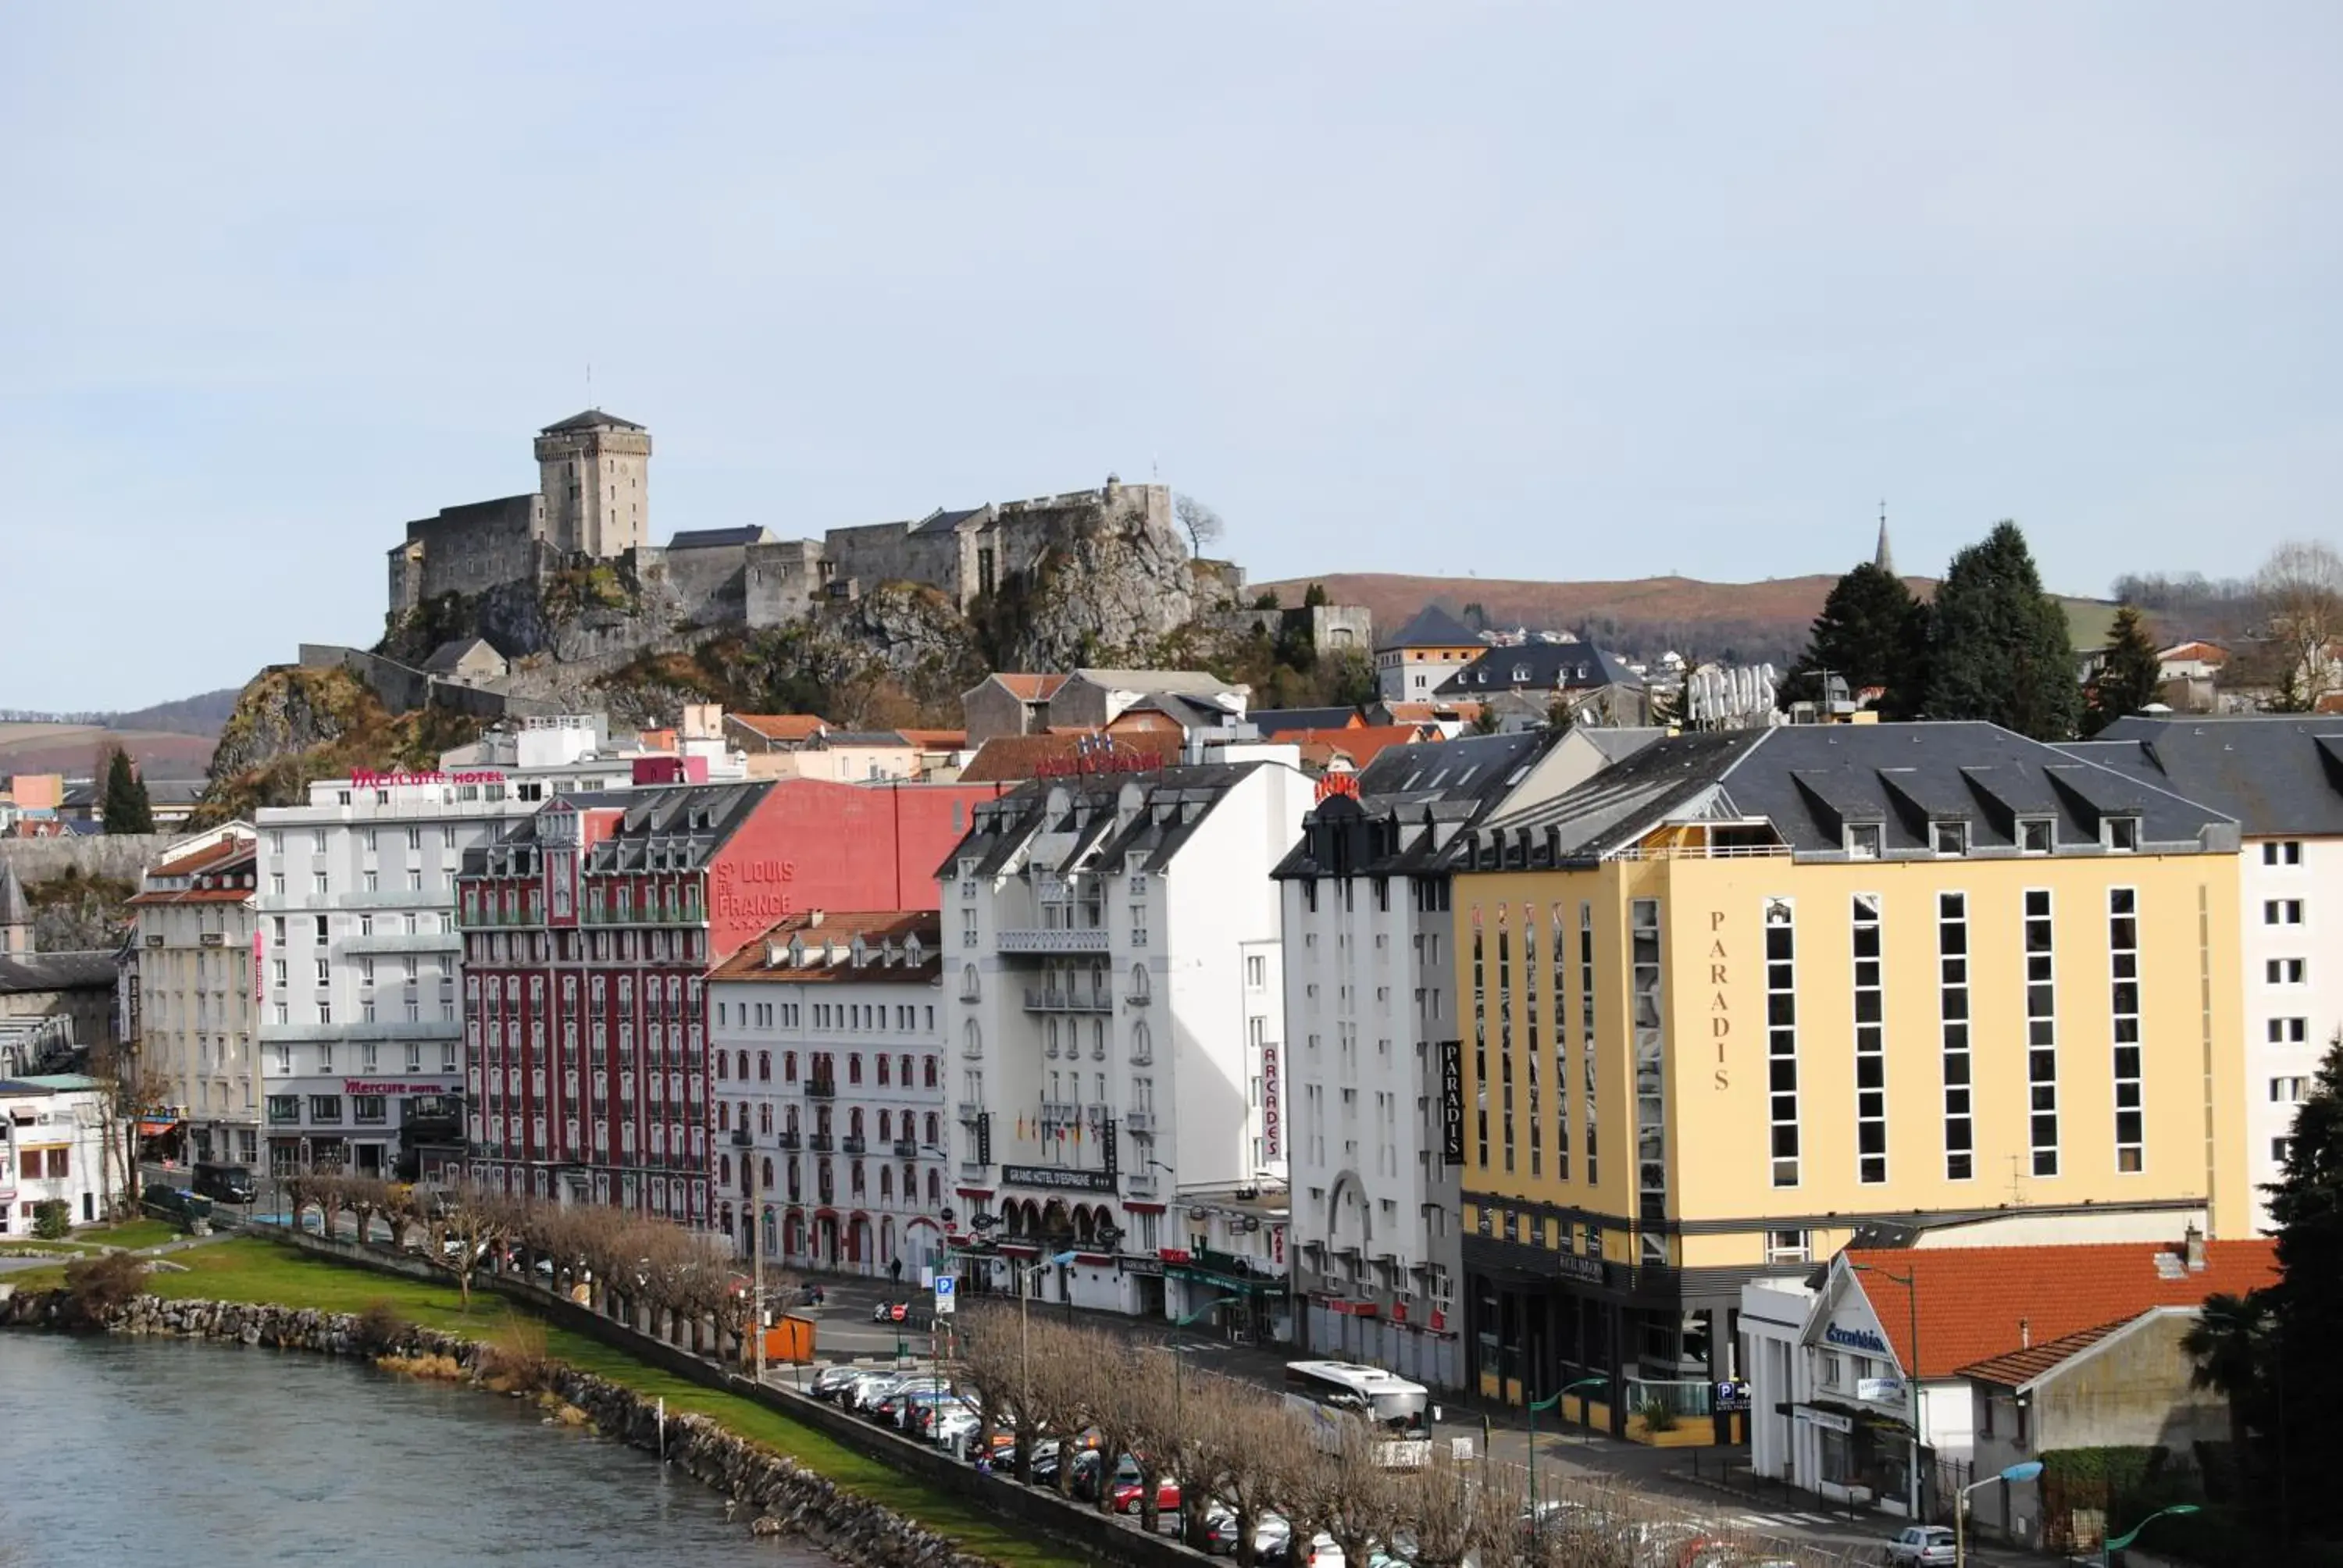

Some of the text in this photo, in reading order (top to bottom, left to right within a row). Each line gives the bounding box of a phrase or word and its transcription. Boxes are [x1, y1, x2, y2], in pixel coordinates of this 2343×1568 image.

[1688, 662, 1774, 720] PARADIS
[350, 767, 505, 789] Mercure HOTEL
[741, 861, 793, 883] LOUIS
[719, 895, 790, 916] FRANCE
[1709, 911, 1730, 1091] PARADIS
[344, 1078, 406, 1094] Mercure
[1264, 1049, 1277, 1154] ARCADES
[1446, 1046, 1460, 1153] PARADIS
